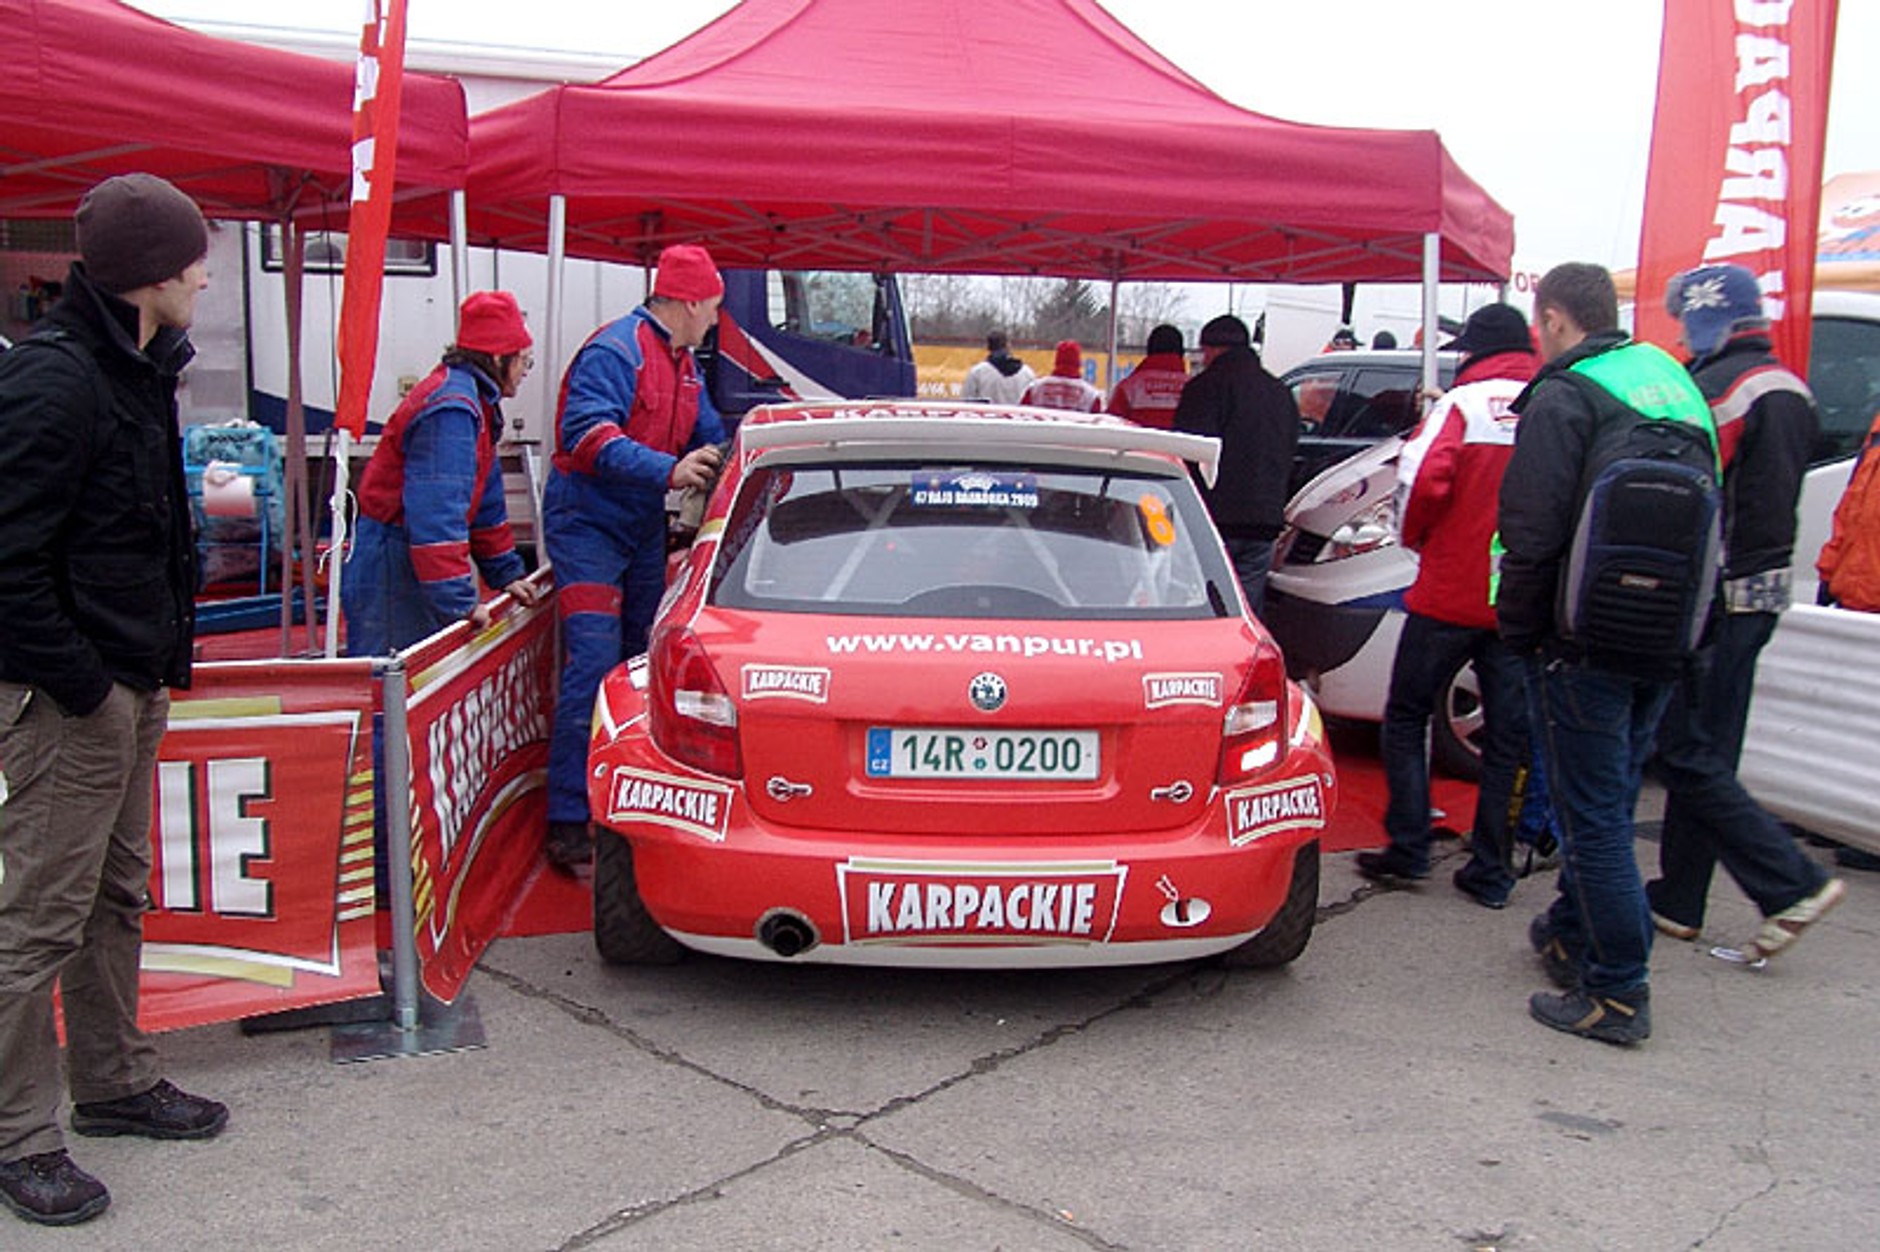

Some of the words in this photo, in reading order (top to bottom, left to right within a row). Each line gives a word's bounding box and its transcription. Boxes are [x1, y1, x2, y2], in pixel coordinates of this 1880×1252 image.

[826, 634, 1143, 661] www.vanpur.pl
[749, 670, 822, 695] KARPACKIE
[1150, 677, 1217, 700] KARPACKIE
[871, 759, 889, 771] CZ
[902, 735, 964, 772] 14R
[994, 737, 1081, 772] 0200
[617, 780, 718, 825] KARPACKIE
[1237, 785, 1321, 830] KARPACKIE
[867, 882, 1096, 935] KARPACKIE
